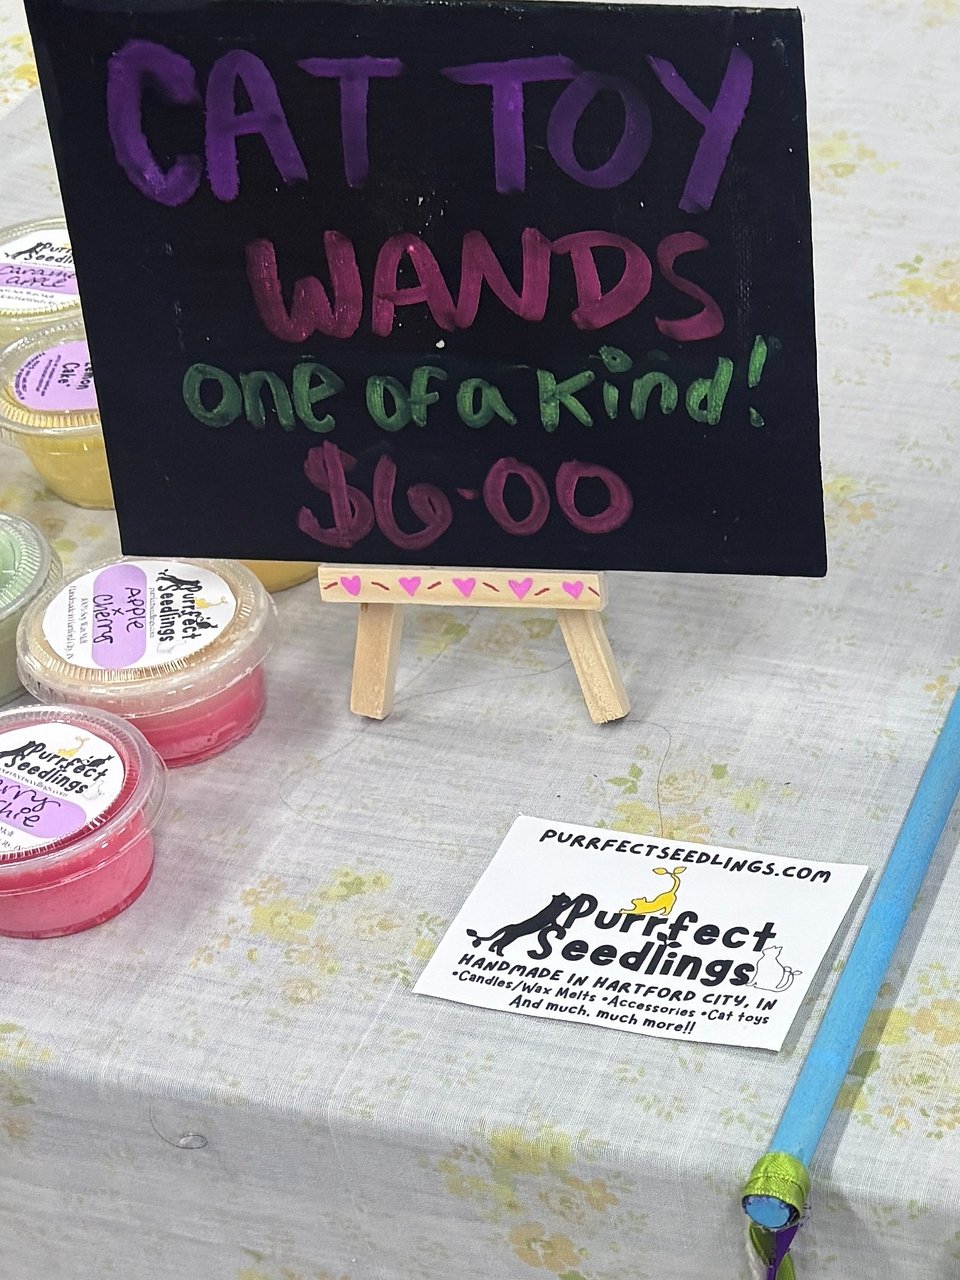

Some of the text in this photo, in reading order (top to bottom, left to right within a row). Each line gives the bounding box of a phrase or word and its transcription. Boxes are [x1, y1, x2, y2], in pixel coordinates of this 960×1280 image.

[107, 38, 755, 214] CAT TOY
[246, 226, 725, 343] WANDS
[297, 440, 634, 551] $6.00
[92, 594, 114, 645] Cherry
[157, 584, 181, 643] Seedlings
[180, 583, 204, 640] Purrfect
[4, 752, 88, 793] Seedlings
[26, 742, 108, 781] Purrfect
[539, 829, 831, 883] PURRFECTSEEDLINGS.COM
[563, 893, 777, 952] Purrfect
[458, 953, 778, 1011] HANDMADE IN HARTFORD CITY, IN
[527, 922, 755, 987] Seedlings
[508, 994, 544, 1009] And
[595, 1009, 638, 1025] much
[642, 1018, 697, 1035] more!!
[555, 987, 597, 1002] Melts
[737, 1011, 770, 1026] toys
